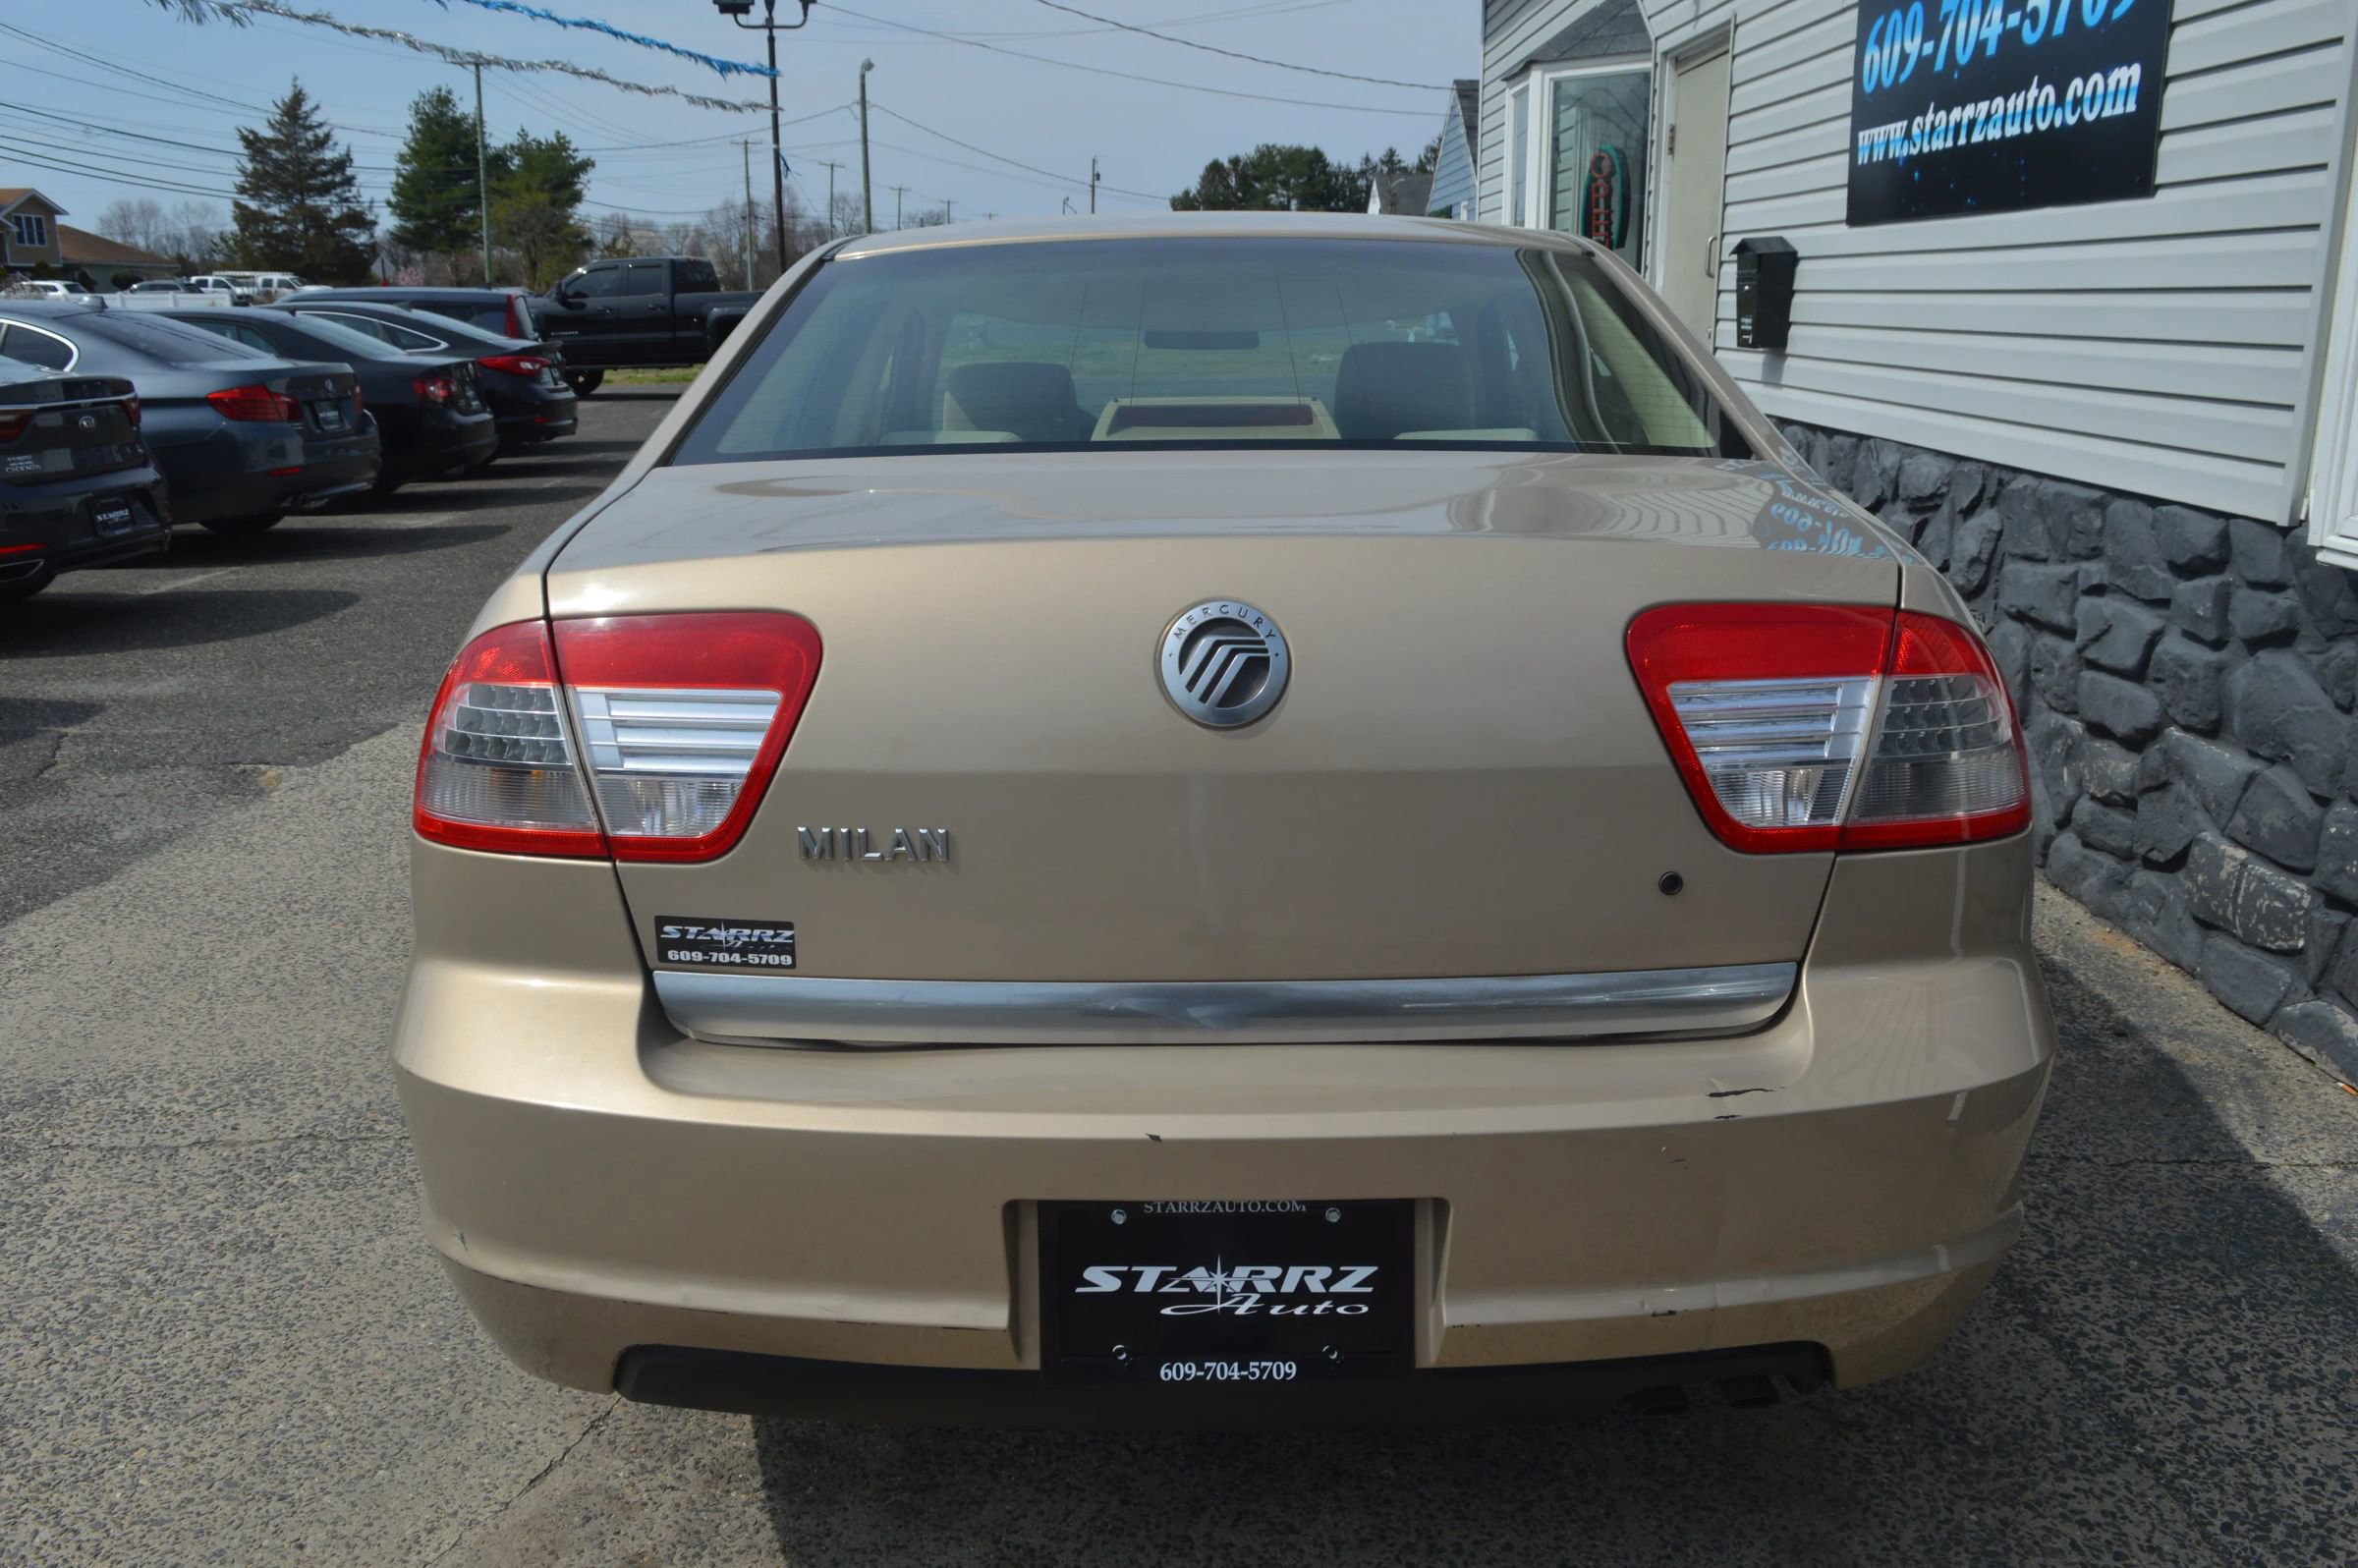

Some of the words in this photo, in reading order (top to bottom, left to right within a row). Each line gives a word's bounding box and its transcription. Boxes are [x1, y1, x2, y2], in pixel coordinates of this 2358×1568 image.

[1862, 0, 2135, 94] 609-704-5
[1857, 62, 2142, 165] www.starrzauto.com
[1591, 152, 1611, 248] OPE
[1173, 604, 1276, 639] MERCURY
[797, 826, 949, 862] MILAN
[660, 924, 794, 942] STARRZ
[668, 949, 793, 965] 609-704-5709
[1144, 1201, 1307, 1214] STARRZAUTO.COM
[1075, 1265, 1378, 1293] STARRZ
[1159, 1293, 1370, 1315] Auto
[1159, 1362, 1297, 1381] 609-704-5709
